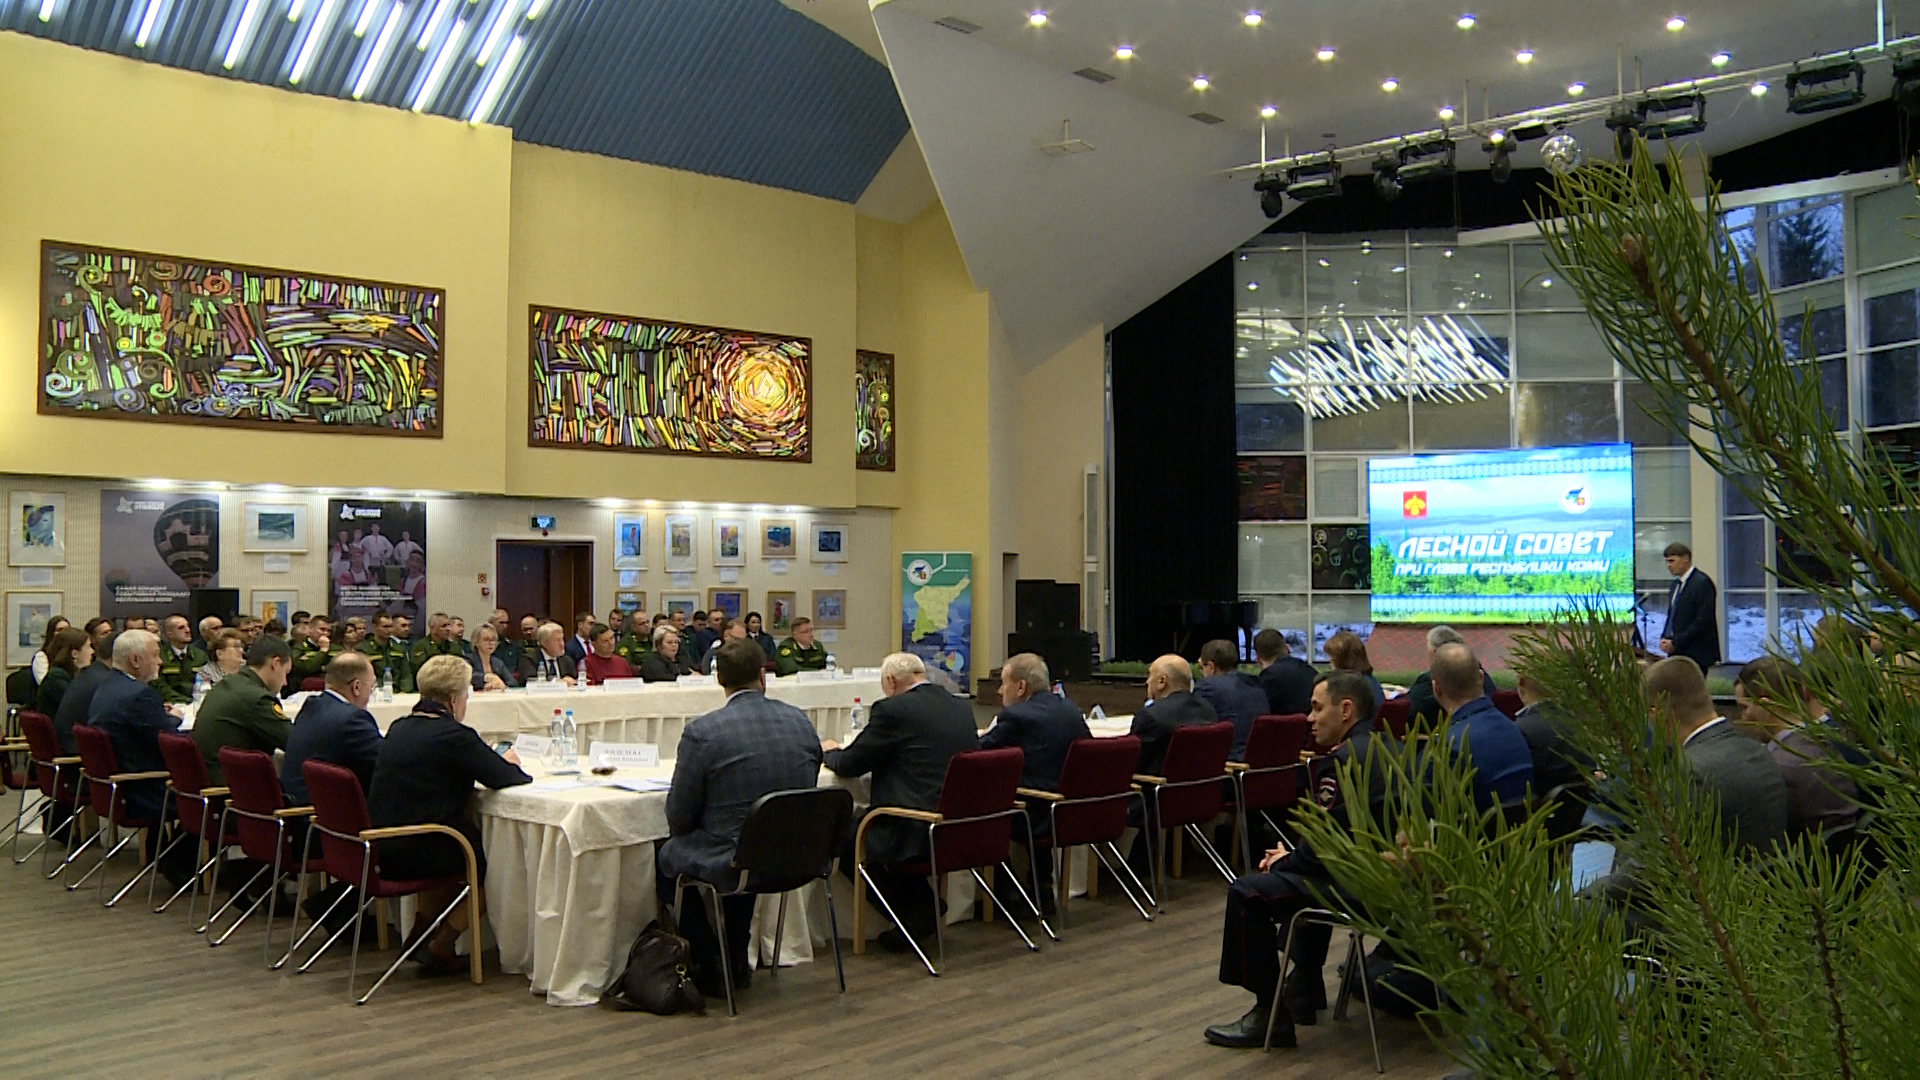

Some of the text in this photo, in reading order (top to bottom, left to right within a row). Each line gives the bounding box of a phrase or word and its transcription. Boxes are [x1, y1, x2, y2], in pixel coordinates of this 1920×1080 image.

[1397, 529, 1614, 558] ЛЕСНОЙ СОВЕТ
[1395, 559, 1610, 576] ПРИ ГЛАВЕ РЕСПУБЛИКИ КОМИ
